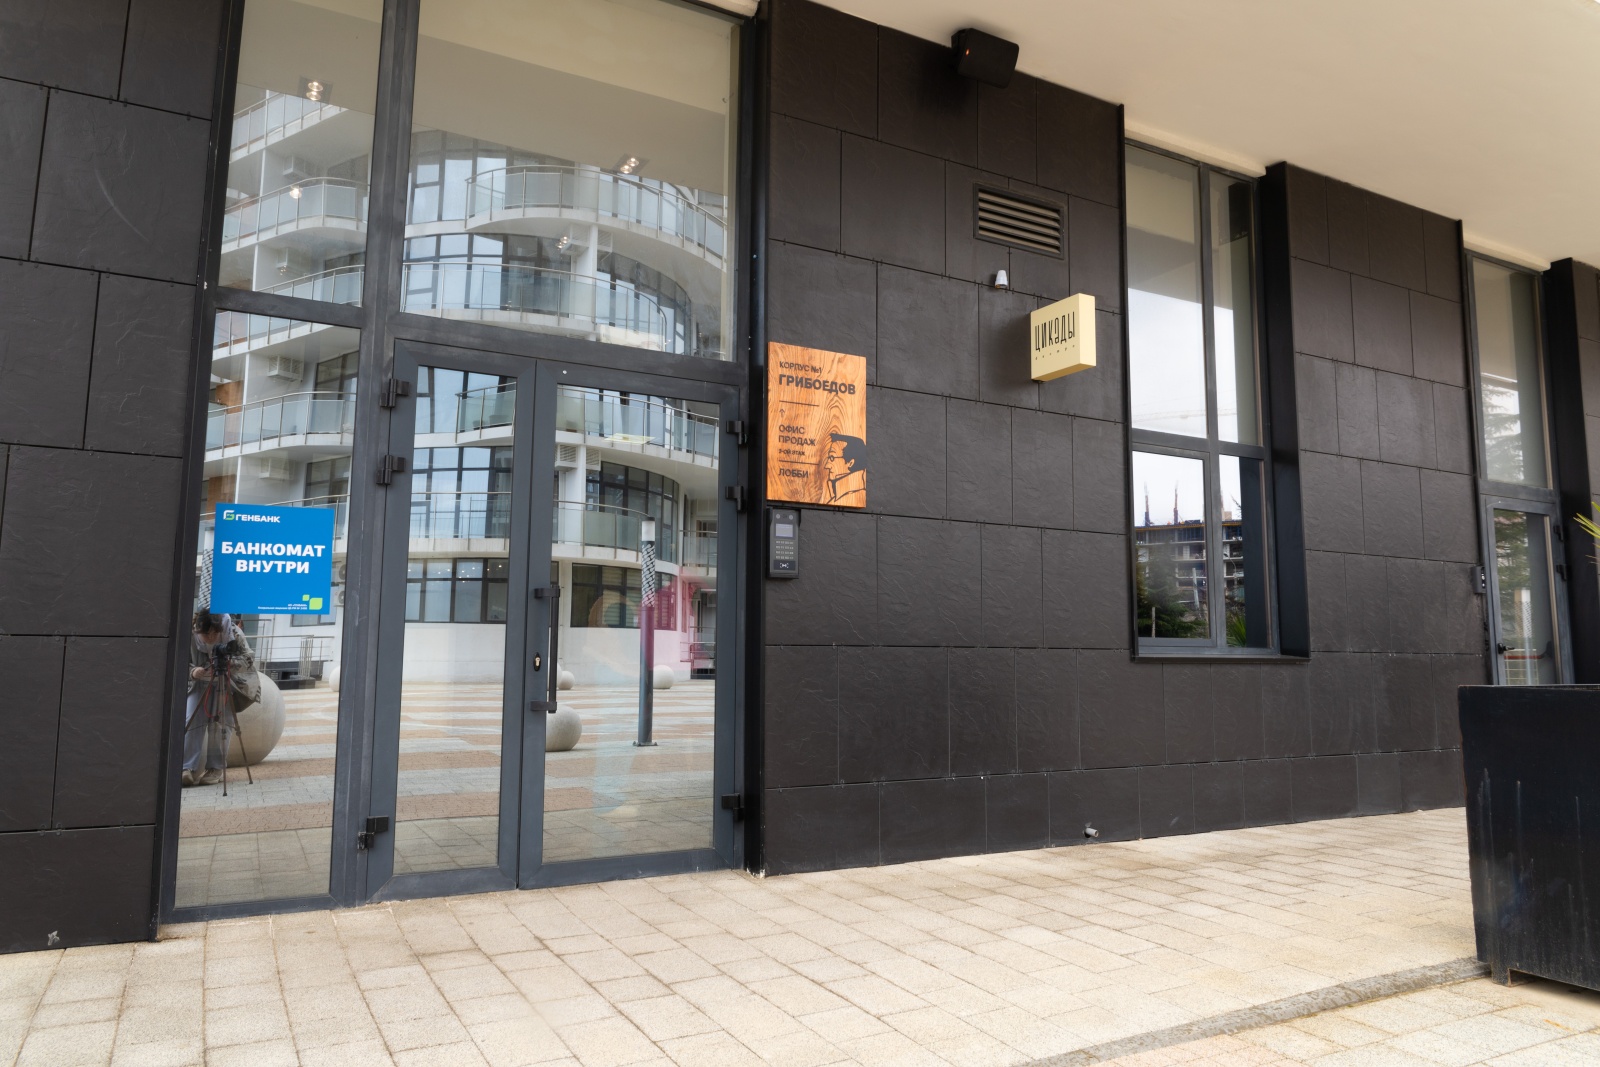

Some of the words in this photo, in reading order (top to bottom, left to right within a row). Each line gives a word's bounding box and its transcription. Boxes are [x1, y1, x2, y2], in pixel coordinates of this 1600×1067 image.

[779, 361, 810, 371] КОРПУС
[779, 374, 856, 394] ГРИБОЕДОВ
[779, 424, 805, 434] ОФИС
[778, 436, 816, 446] ПРОДАЖ
[778, 468, 809, 479] ЛОББИ
[235, 513, 281, 523] ГЕНБАНК
[221, 541, 326, 557] БАНКОМАТ
[236, 559, 310, 573] ВНУТРИ
